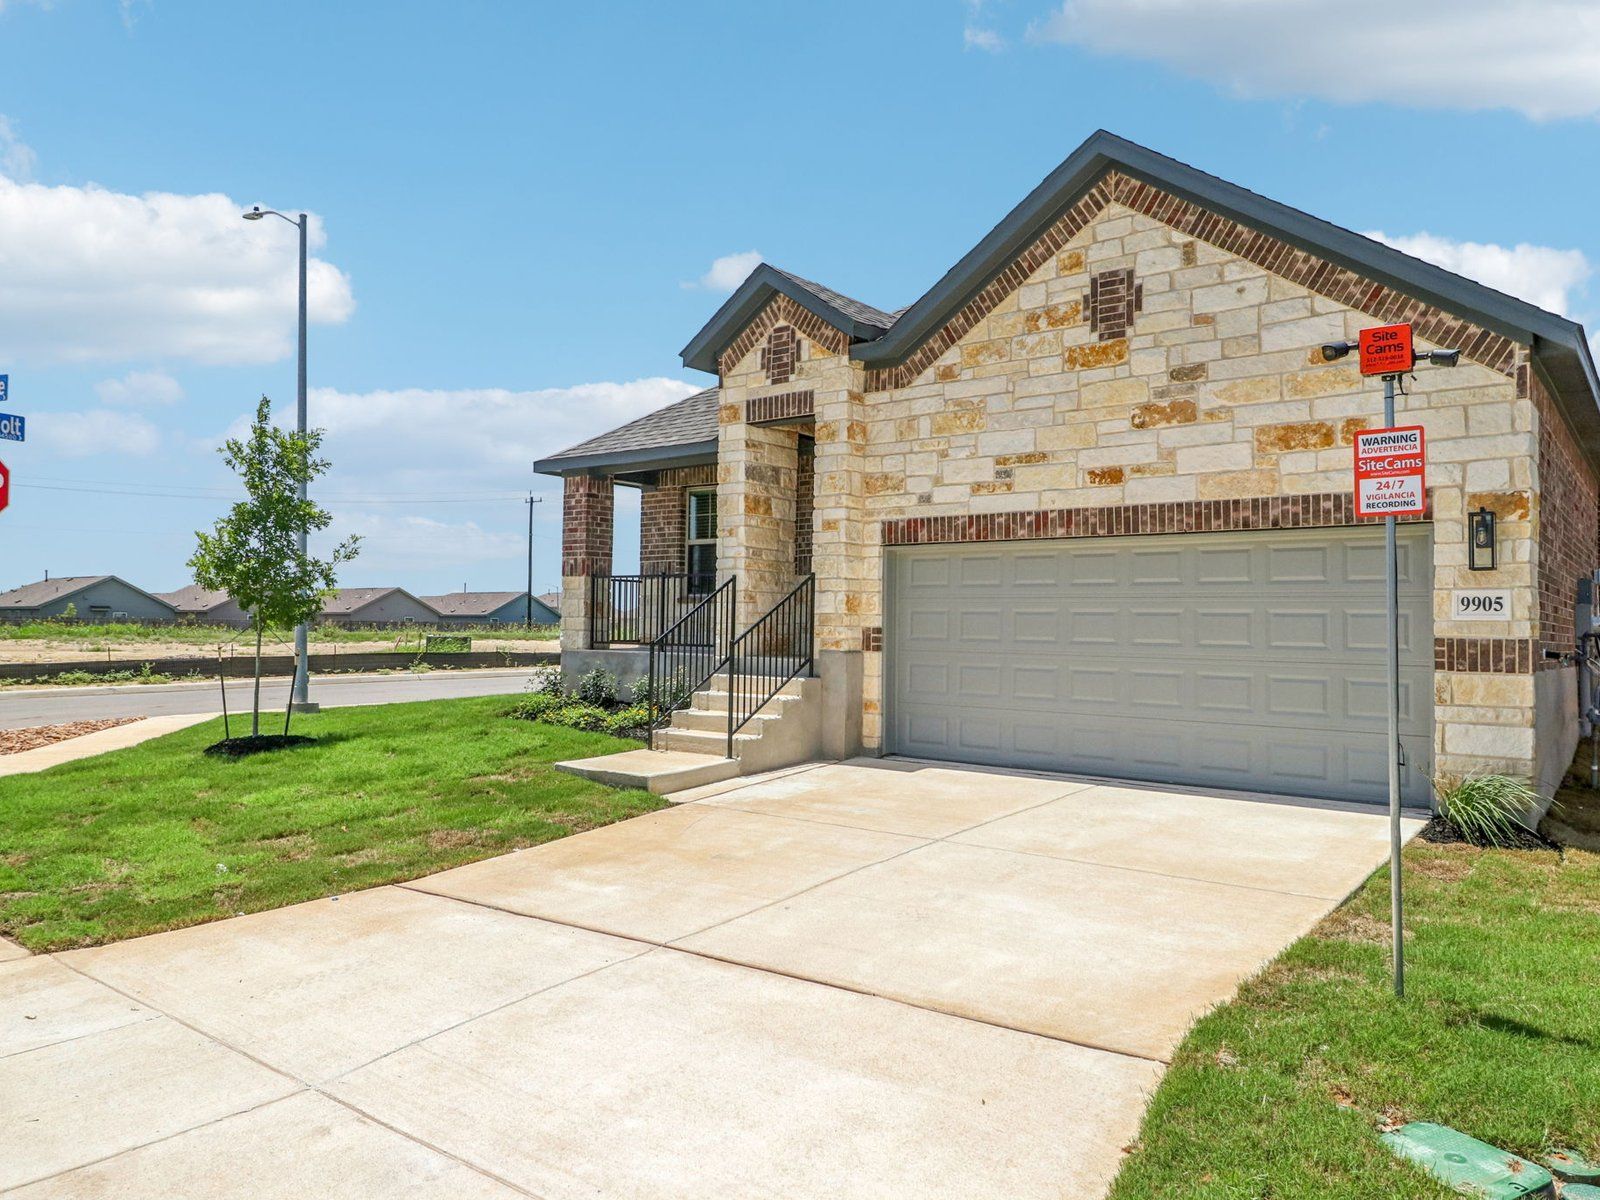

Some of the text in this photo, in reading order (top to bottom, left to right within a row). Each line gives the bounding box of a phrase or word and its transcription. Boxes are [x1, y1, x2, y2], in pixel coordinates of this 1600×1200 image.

[1372, 331, 1397, 342] Site
[1366, 343, 1404, 355] Cams
[1361, 433, 1417, 447] WARNING
[1361, 443, 1418, 455] ADVERTENCIA
[1358, 458, 1422, 472] SiteCams
[1376, 480, 1405, 491] 24/7
[1366, 491, 1416, 501] VIGILANCIA
[1366, 499, 1416, 509] RECORDING
[1460, 596, 1504, 612] 9905
